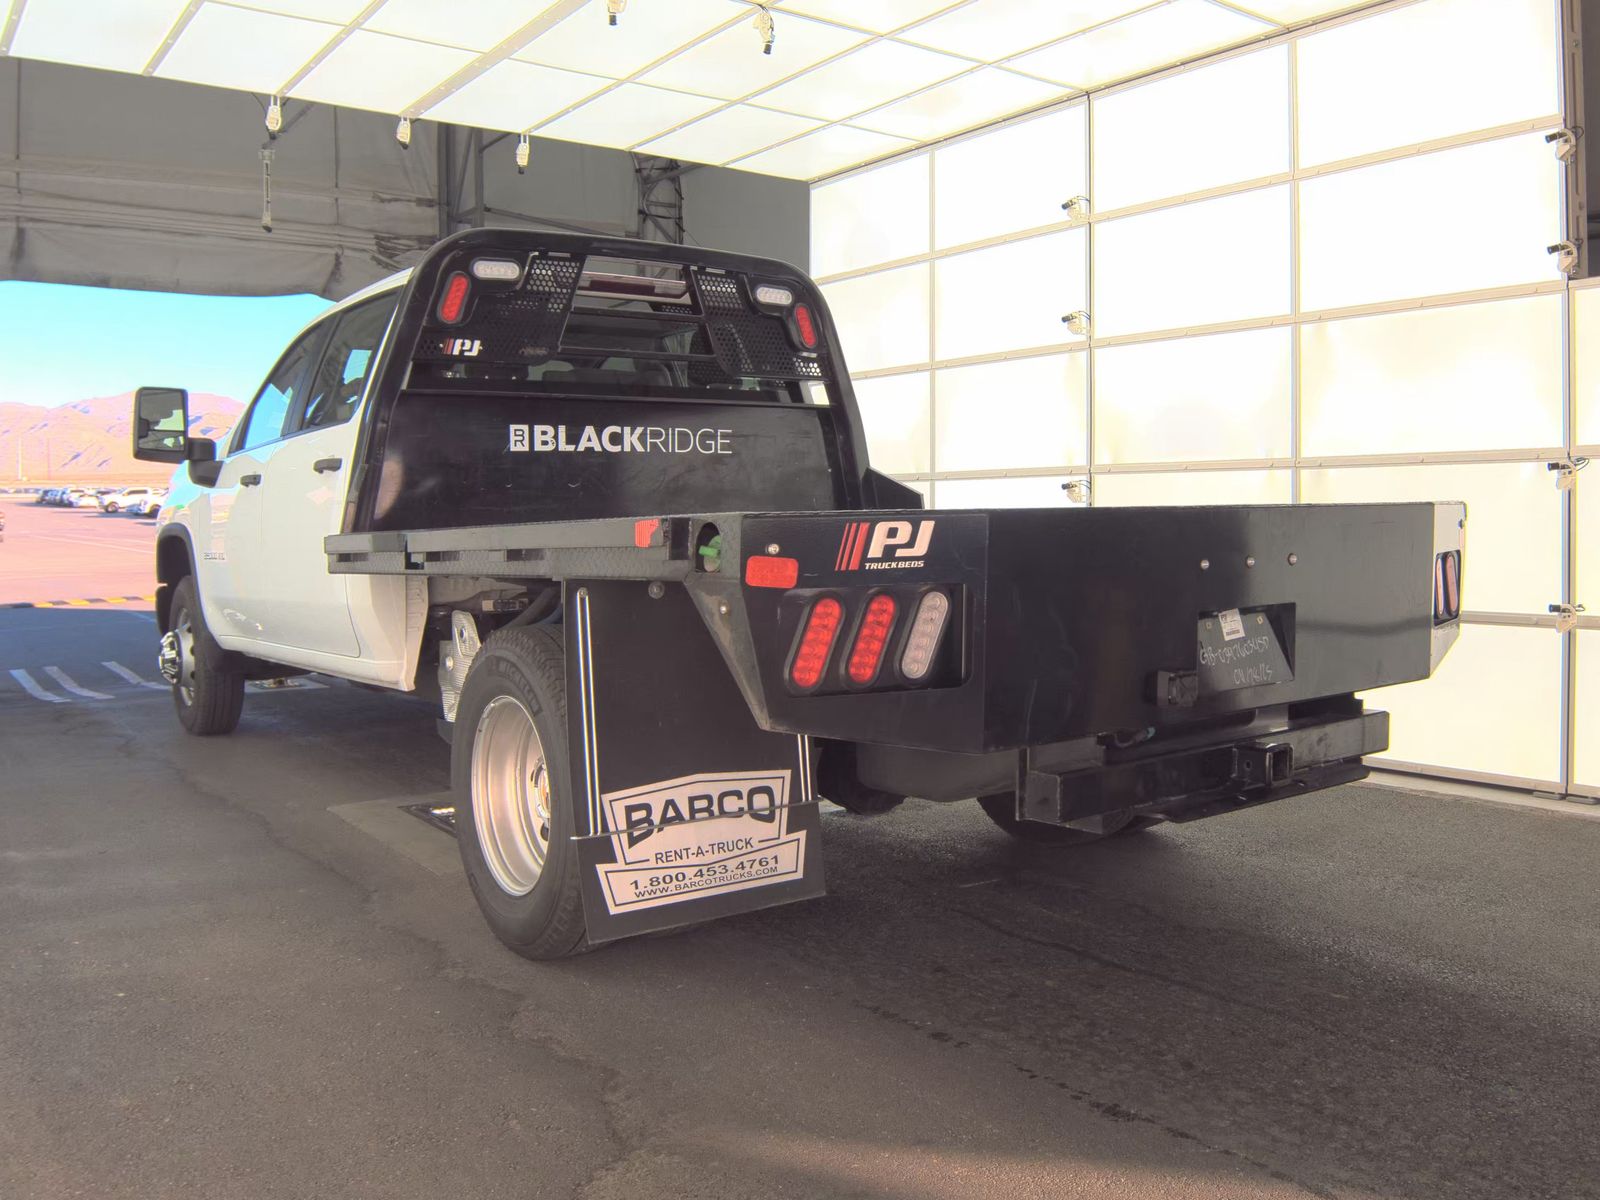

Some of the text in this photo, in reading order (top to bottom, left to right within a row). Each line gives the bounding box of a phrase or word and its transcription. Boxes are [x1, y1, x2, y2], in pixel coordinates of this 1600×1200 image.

[452, 338, 481, 356] PJ
[534, 425, 733, 454] BLACKRIDGE
[867, 520, 935, 558] PJ
[624, 785, 776, 849] BARCO
[654, 837, 754, 864] RENT-A-TRUCK
[630, 855, 779, 890] 1.800.453.4761
[634, 866, 778, 898] WWW.BARCOTRUCKS.COM
